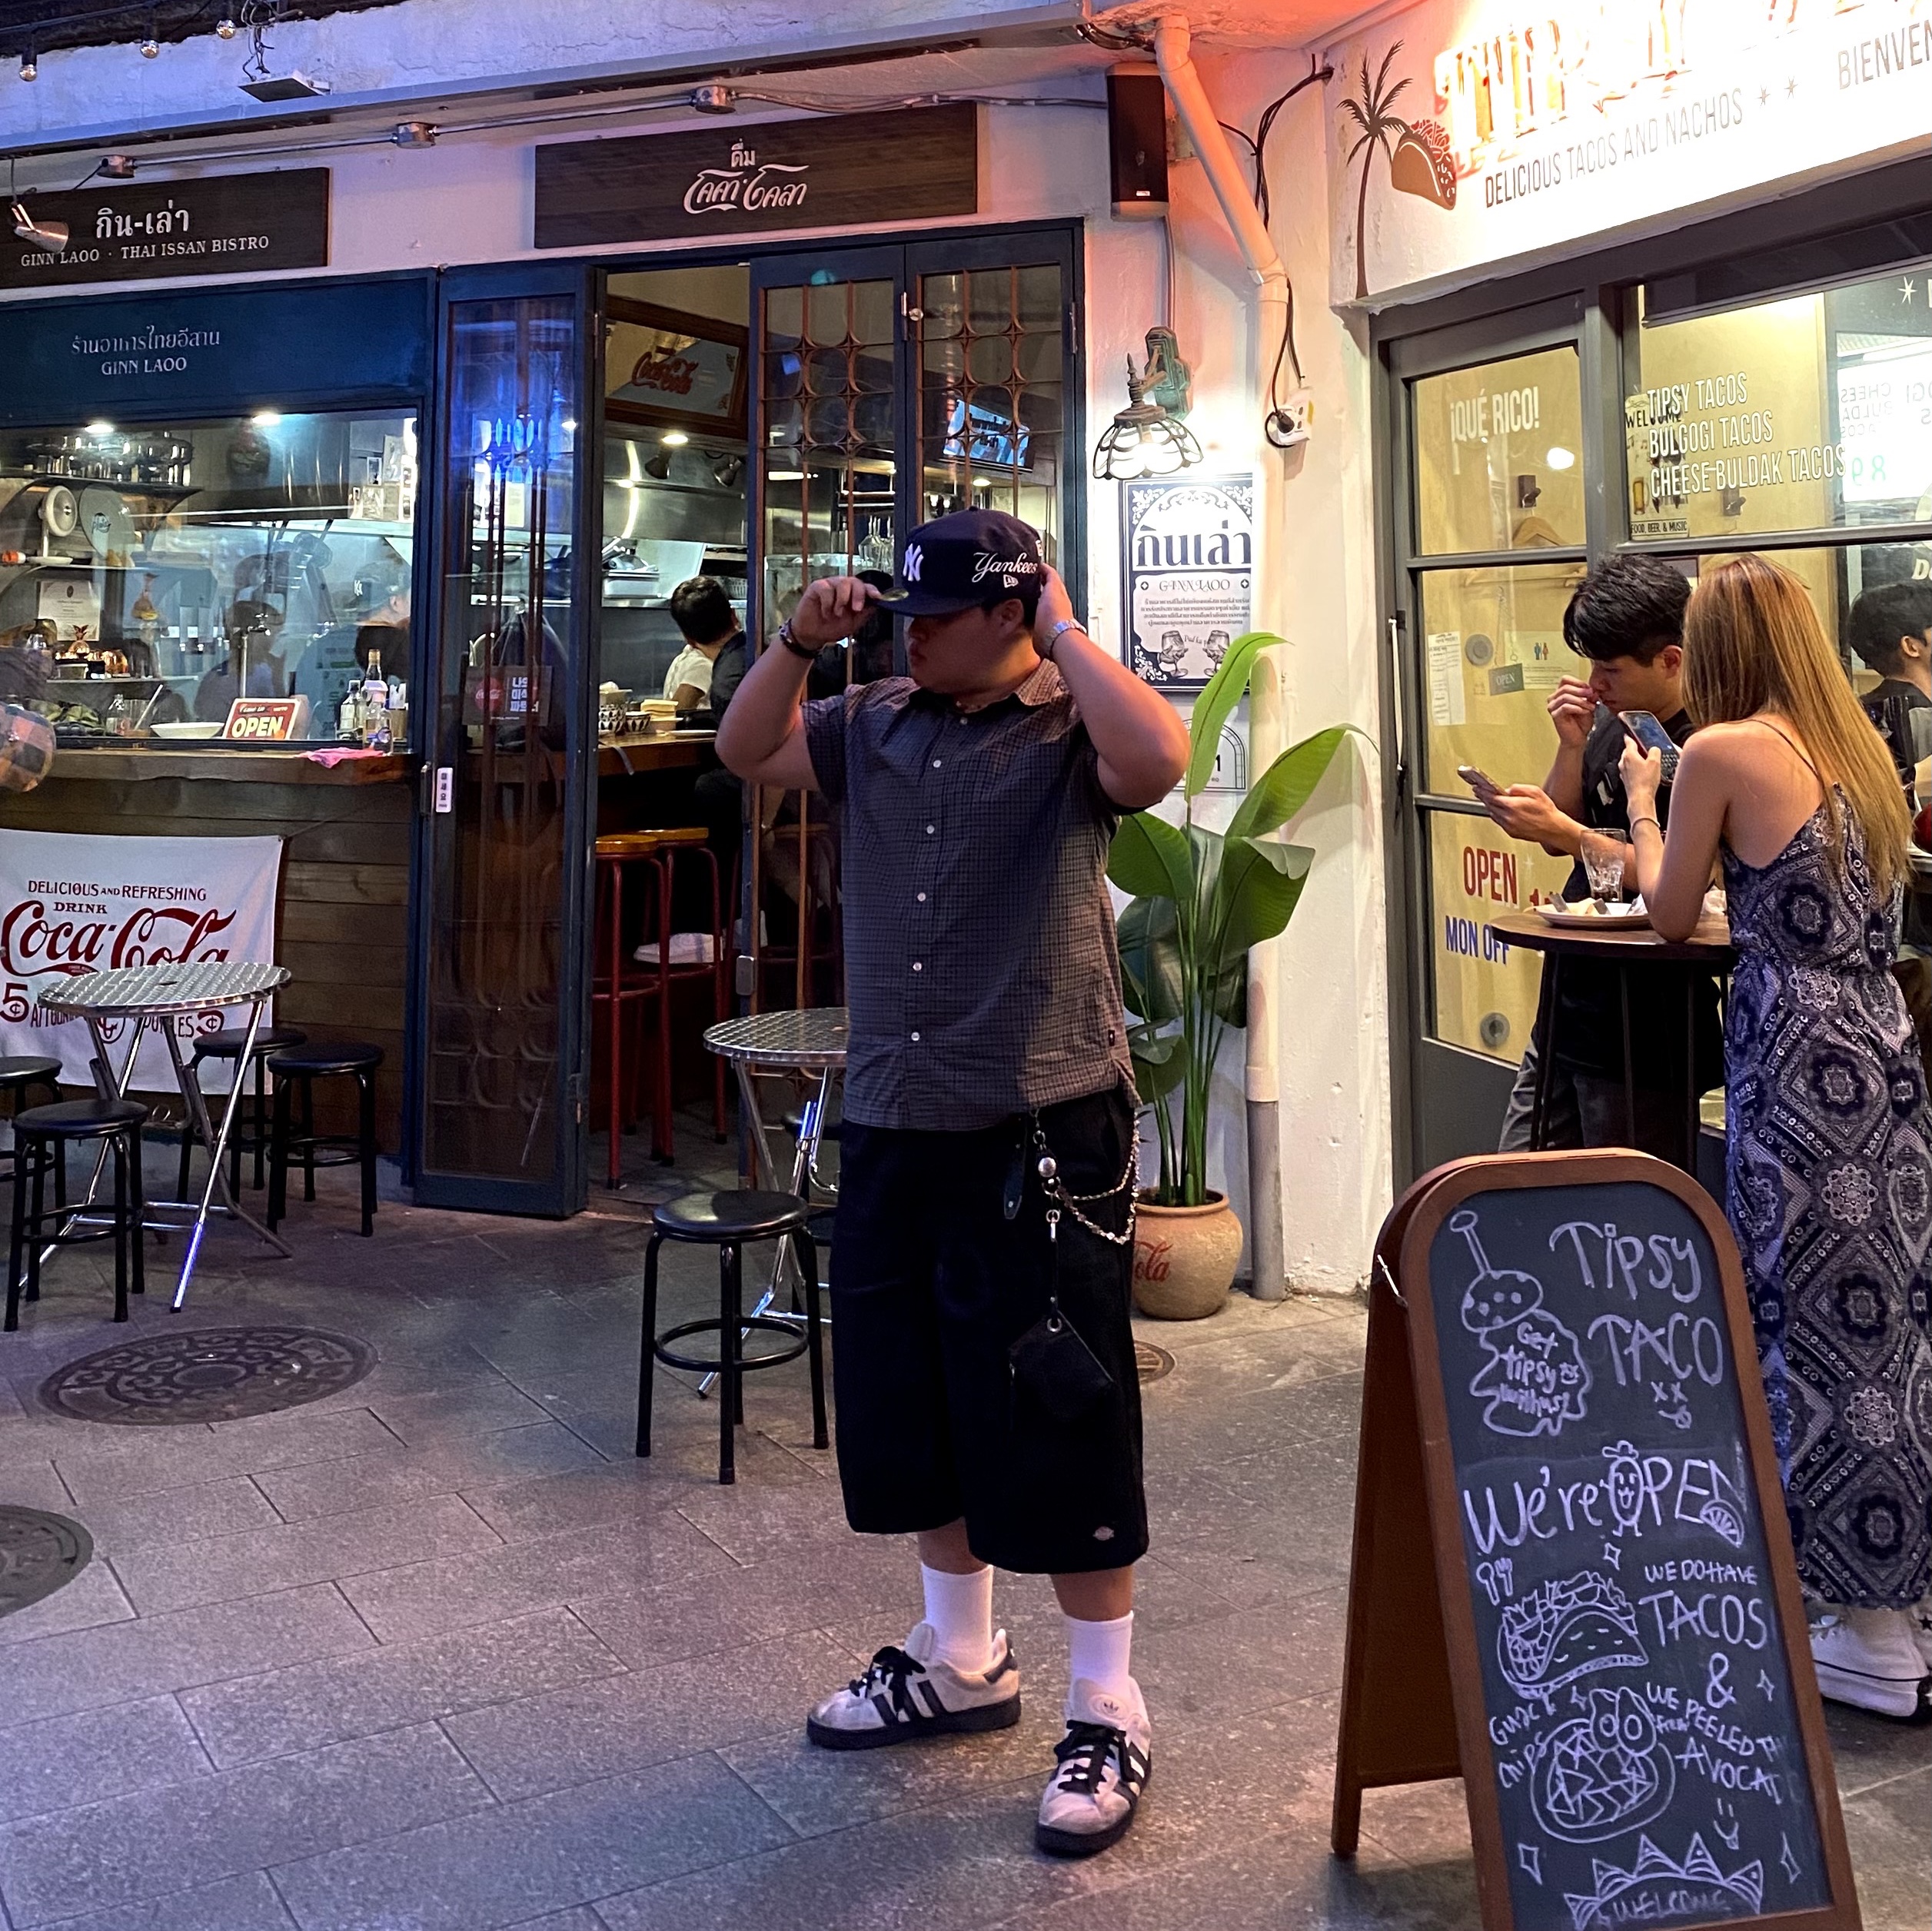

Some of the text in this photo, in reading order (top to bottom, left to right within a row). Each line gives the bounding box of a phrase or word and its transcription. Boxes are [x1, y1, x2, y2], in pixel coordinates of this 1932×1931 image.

[731, 138, 756, 167] ดื่ม
[1486, 88, 1743, 208] DELICIOUS TACOS AND NACHOS
[96, 199, 190, 238] กิน-เล่า
[21, 236, 270, 267] GINN LAOO THAI ISSAN BISTRO
[101, 357, 187, 375] GINN LAOO
[1491, 386, 1540, 436] RICO!
[1648, 372, 1747, 418] TIPSY TACOS
[1649, 410, 1774, 458] BULGOGI TACOS
[1787, 443, 1846, 480] TACOS
[1669, 520, 1688, 531] MUSIC
[971, 552, 1038, 583] Yankees
[231, 716, 284, 738] OPEN
[28, 880, 207, 901] DELICIOUS AND REFRESHING
[1463, 846, 1518, 906] OPEN
[53, 902, 108, 914] DRINK
[1445, 916, 1479, 958] MON
[1588, 1312, 1722, 1385] TACO
[1644, 1561, 1677, 1584] WE
[1638, 1590, 1767, 1650] TACOS
[1706, 1653, 1737, 1709] &
